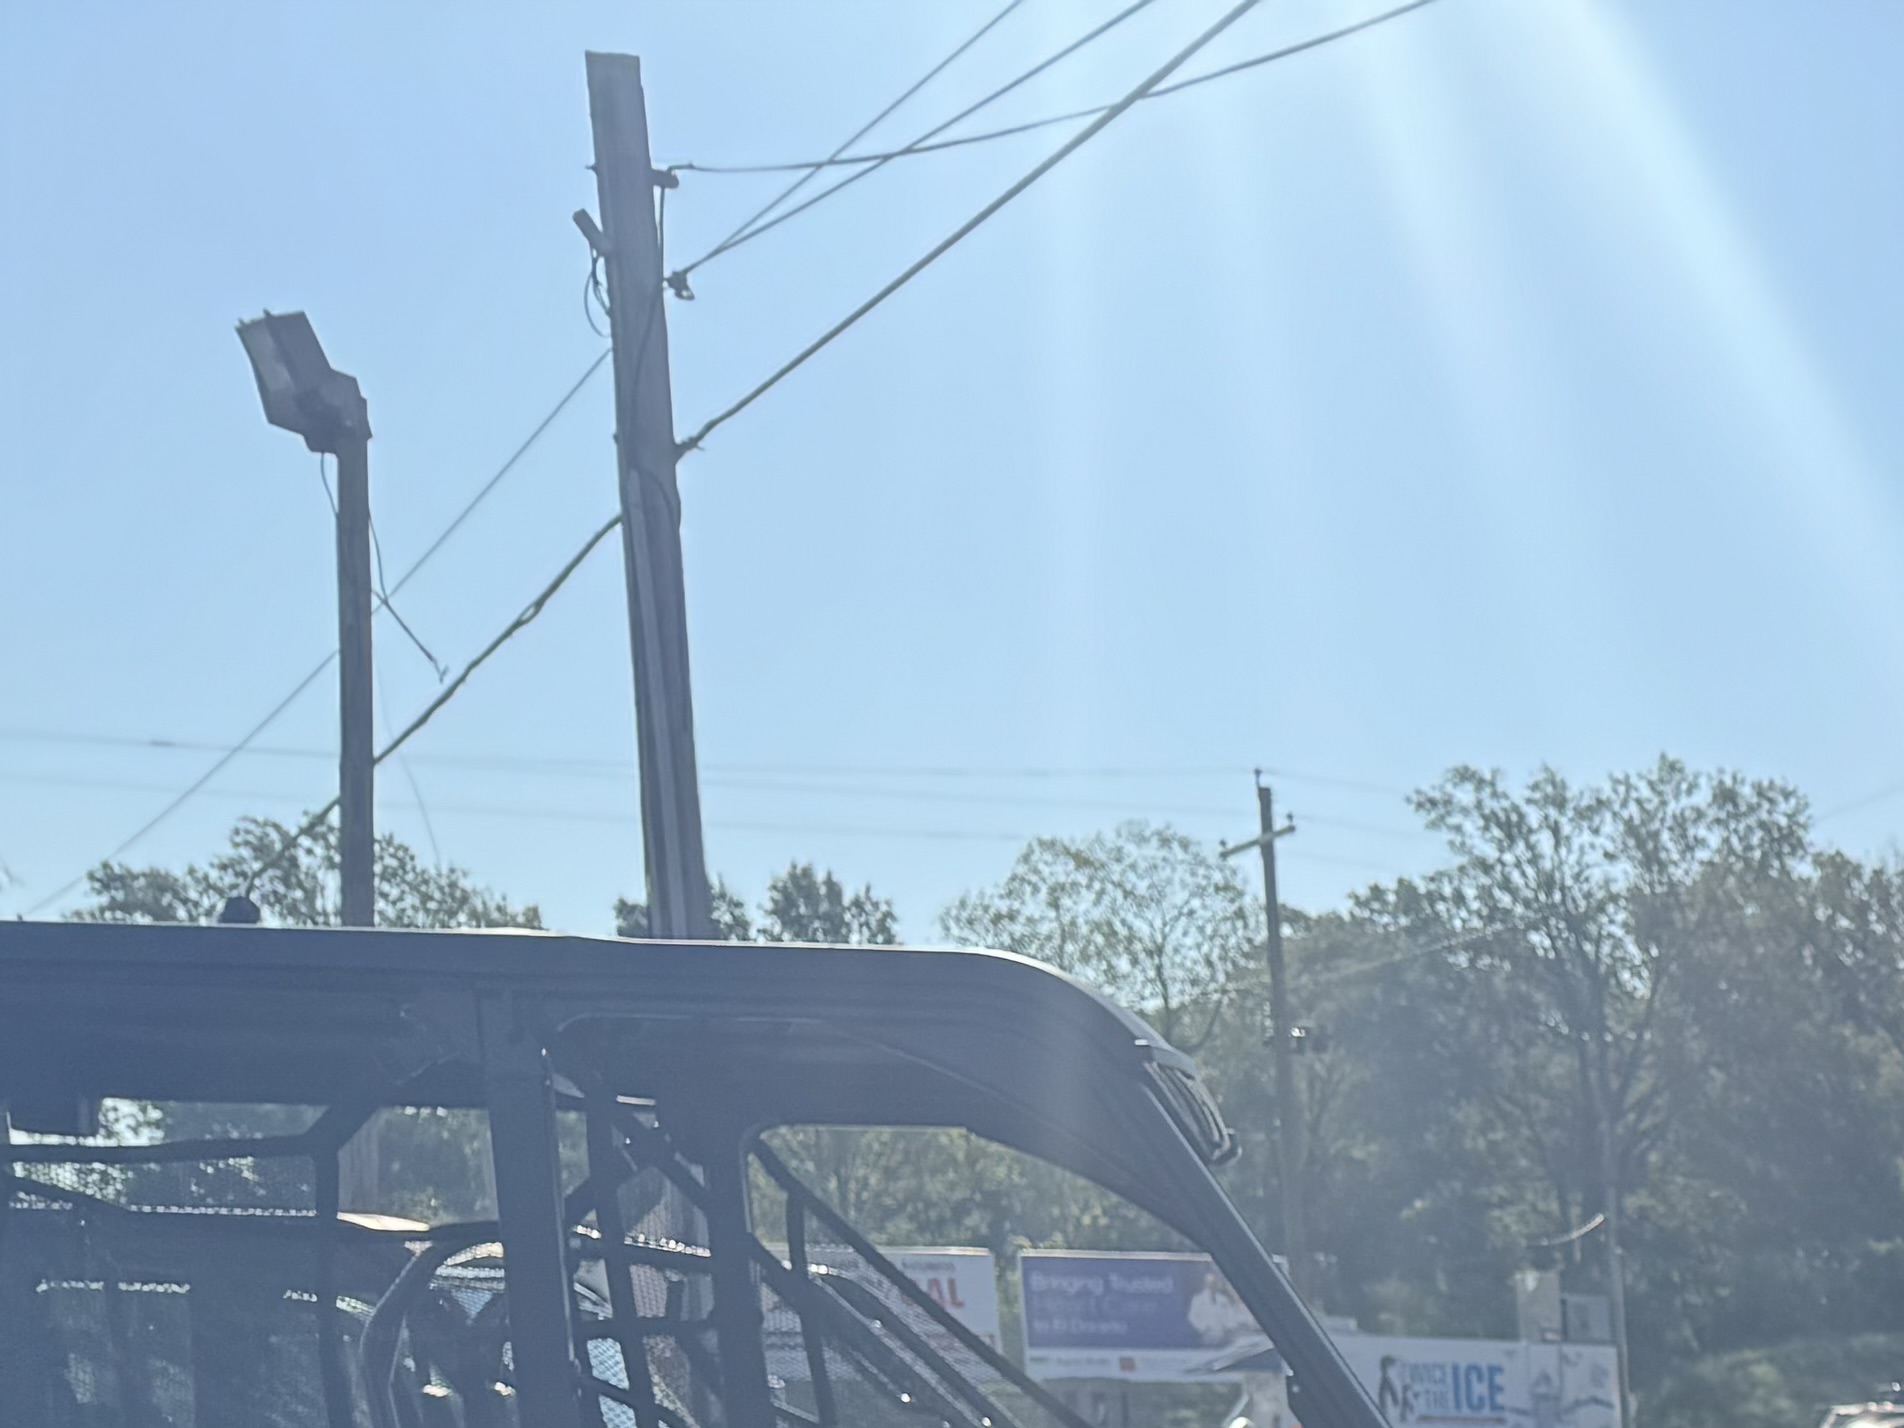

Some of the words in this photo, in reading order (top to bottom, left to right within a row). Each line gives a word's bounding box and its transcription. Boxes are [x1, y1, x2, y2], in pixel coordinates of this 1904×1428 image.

[1029, 1271, 1104, 1295] Bringing
[1109, 1272, 1174, 1295] Trusted
[1451, 1362, 1505, 1412] ICE
